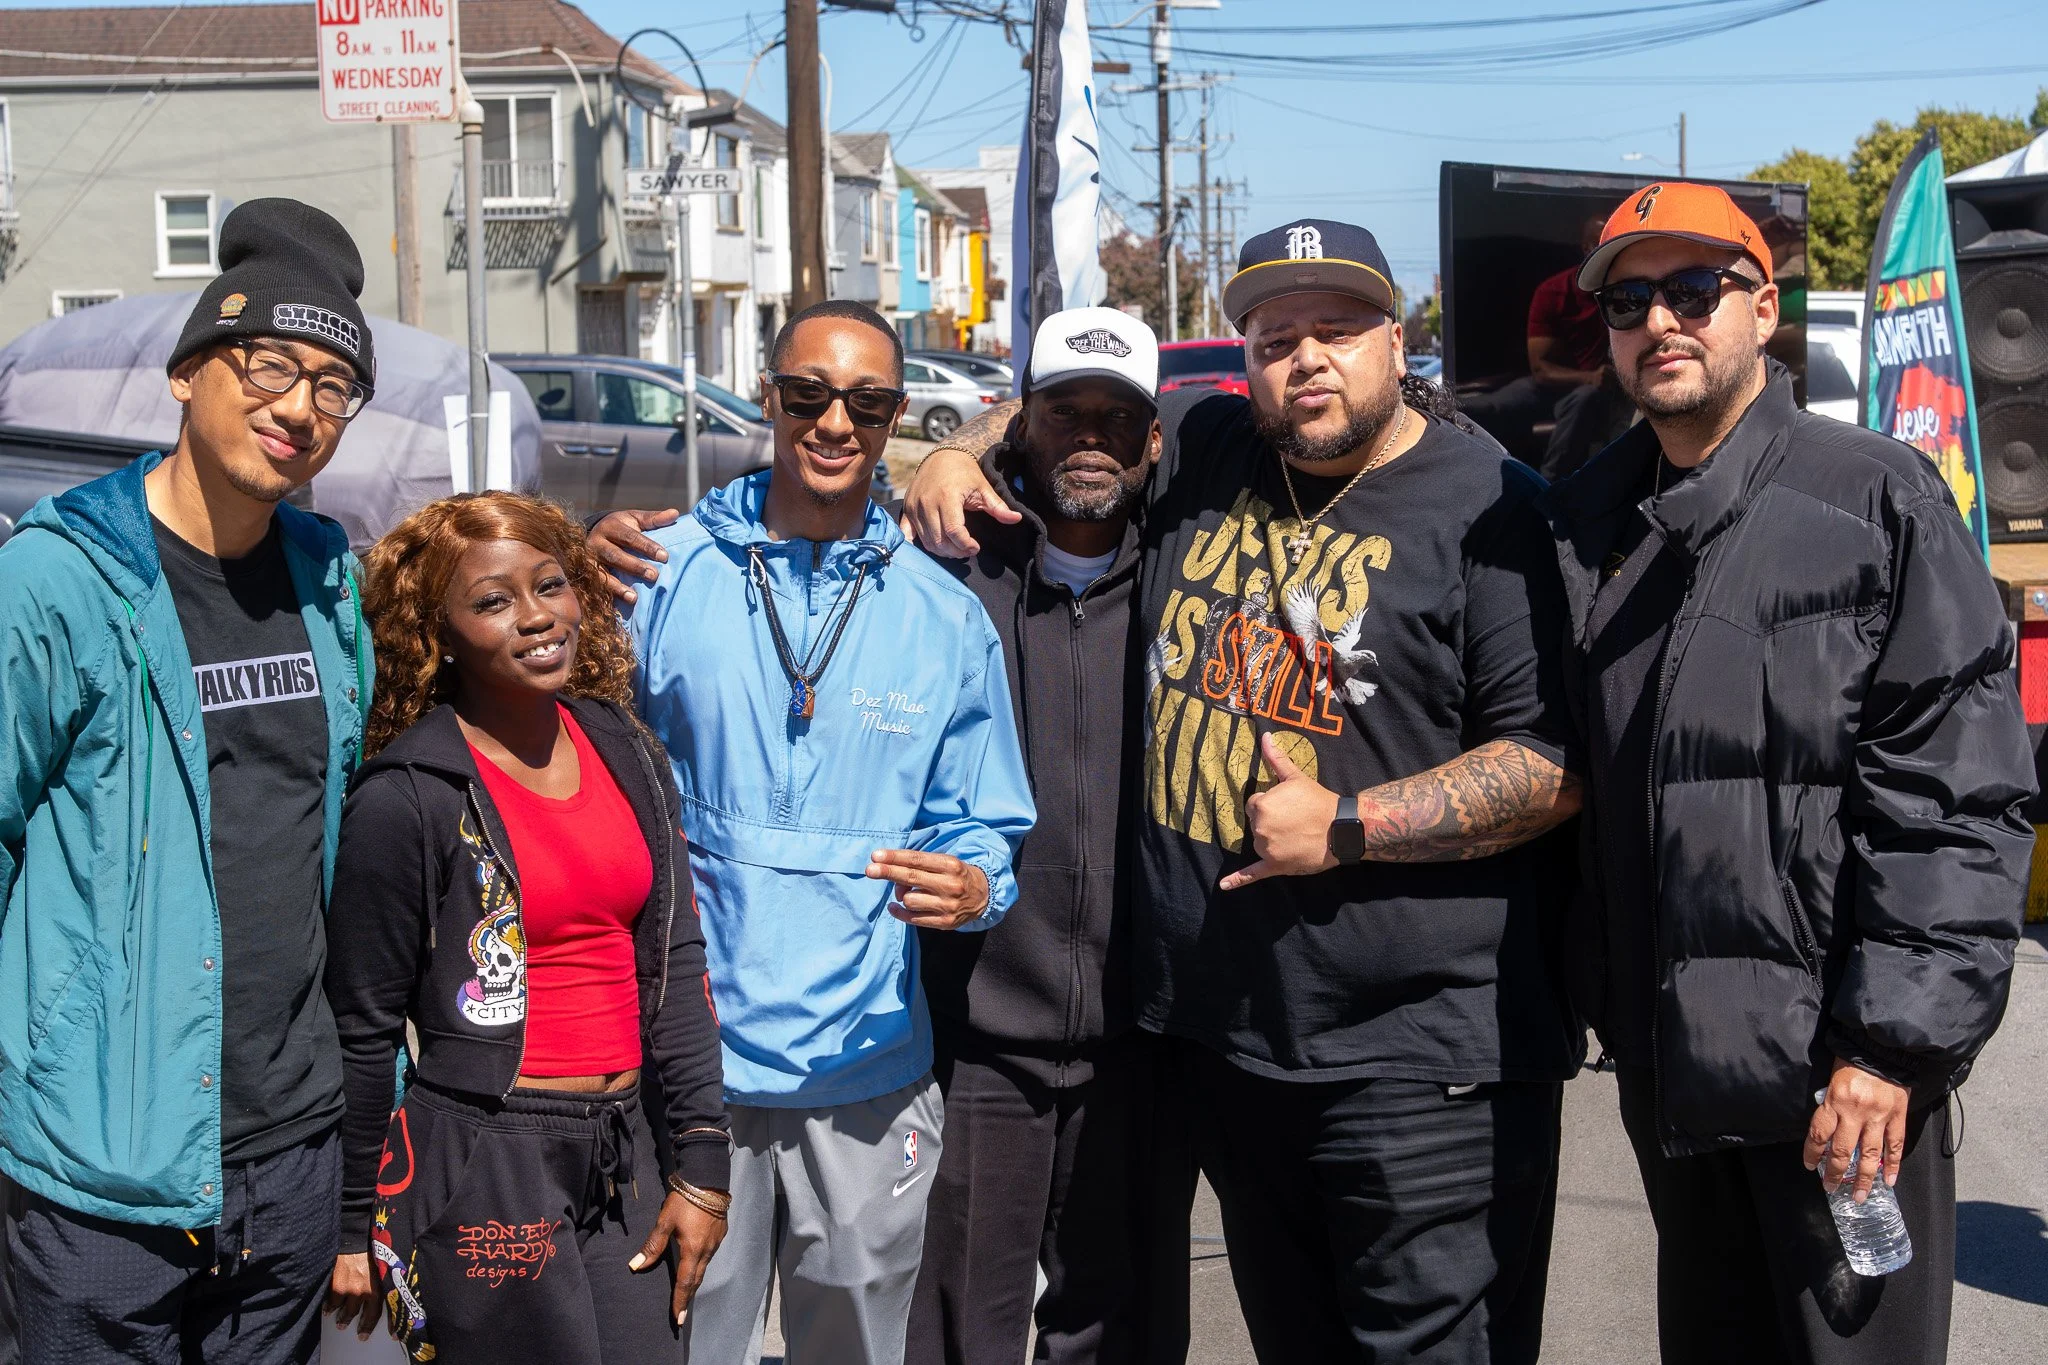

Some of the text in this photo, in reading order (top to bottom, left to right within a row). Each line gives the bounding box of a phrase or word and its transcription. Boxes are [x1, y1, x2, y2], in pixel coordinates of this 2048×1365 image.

[322, 0, 443, 23] NO PARKING
[332, 66, 443, 90] WEDNESDAY
[338, 99, 440, 116] STREET CLEANING
[640, 173, 729, 191] SAWYER
[276, 305, 359, 344] LYRICAL
[1087, 331, 1110, 341] VANS
[1089, 338, 1106, 350] THE
[2008, 519, 2044, 532] YAMAHA
[1182, 487, 1392, 633] JESUS
[1202, 611, 1343, 737] STILL
[851, 687, 927, 714] Dez Mac
[861, 711, 912, 735] Music
[477, 1001, 525, 1019] CITY
[458, 1220, 516, 1242] DON
[375, 1245, 394, 1261] EW
[466, 1262, 527, 1288] designs
